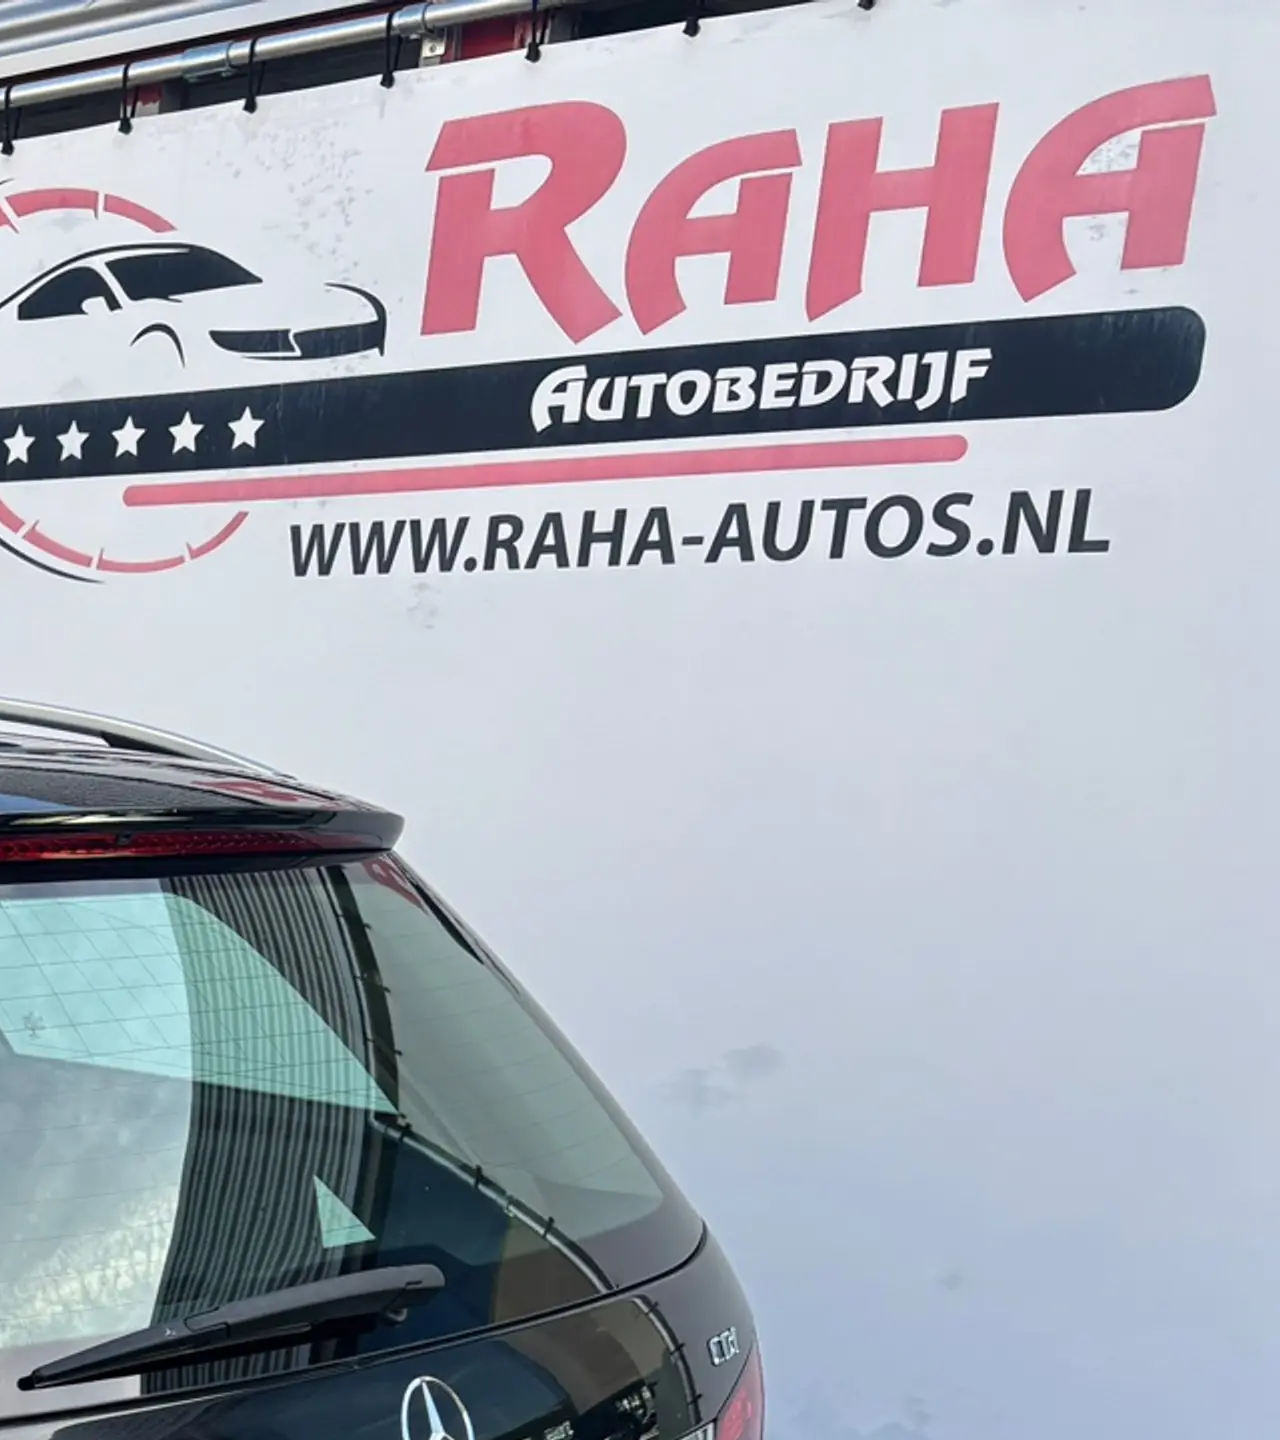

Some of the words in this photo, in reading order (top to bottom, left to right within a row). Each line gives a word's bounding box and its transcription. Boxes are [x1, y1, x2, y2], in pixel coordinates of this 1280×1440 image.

[419, 74, 1216, 344] RAHA
[530, 348, 993, 432] AUTOBEDRIJF
[289, 488, 1111, 578] WWW.RAHA-AUTOS.NL
